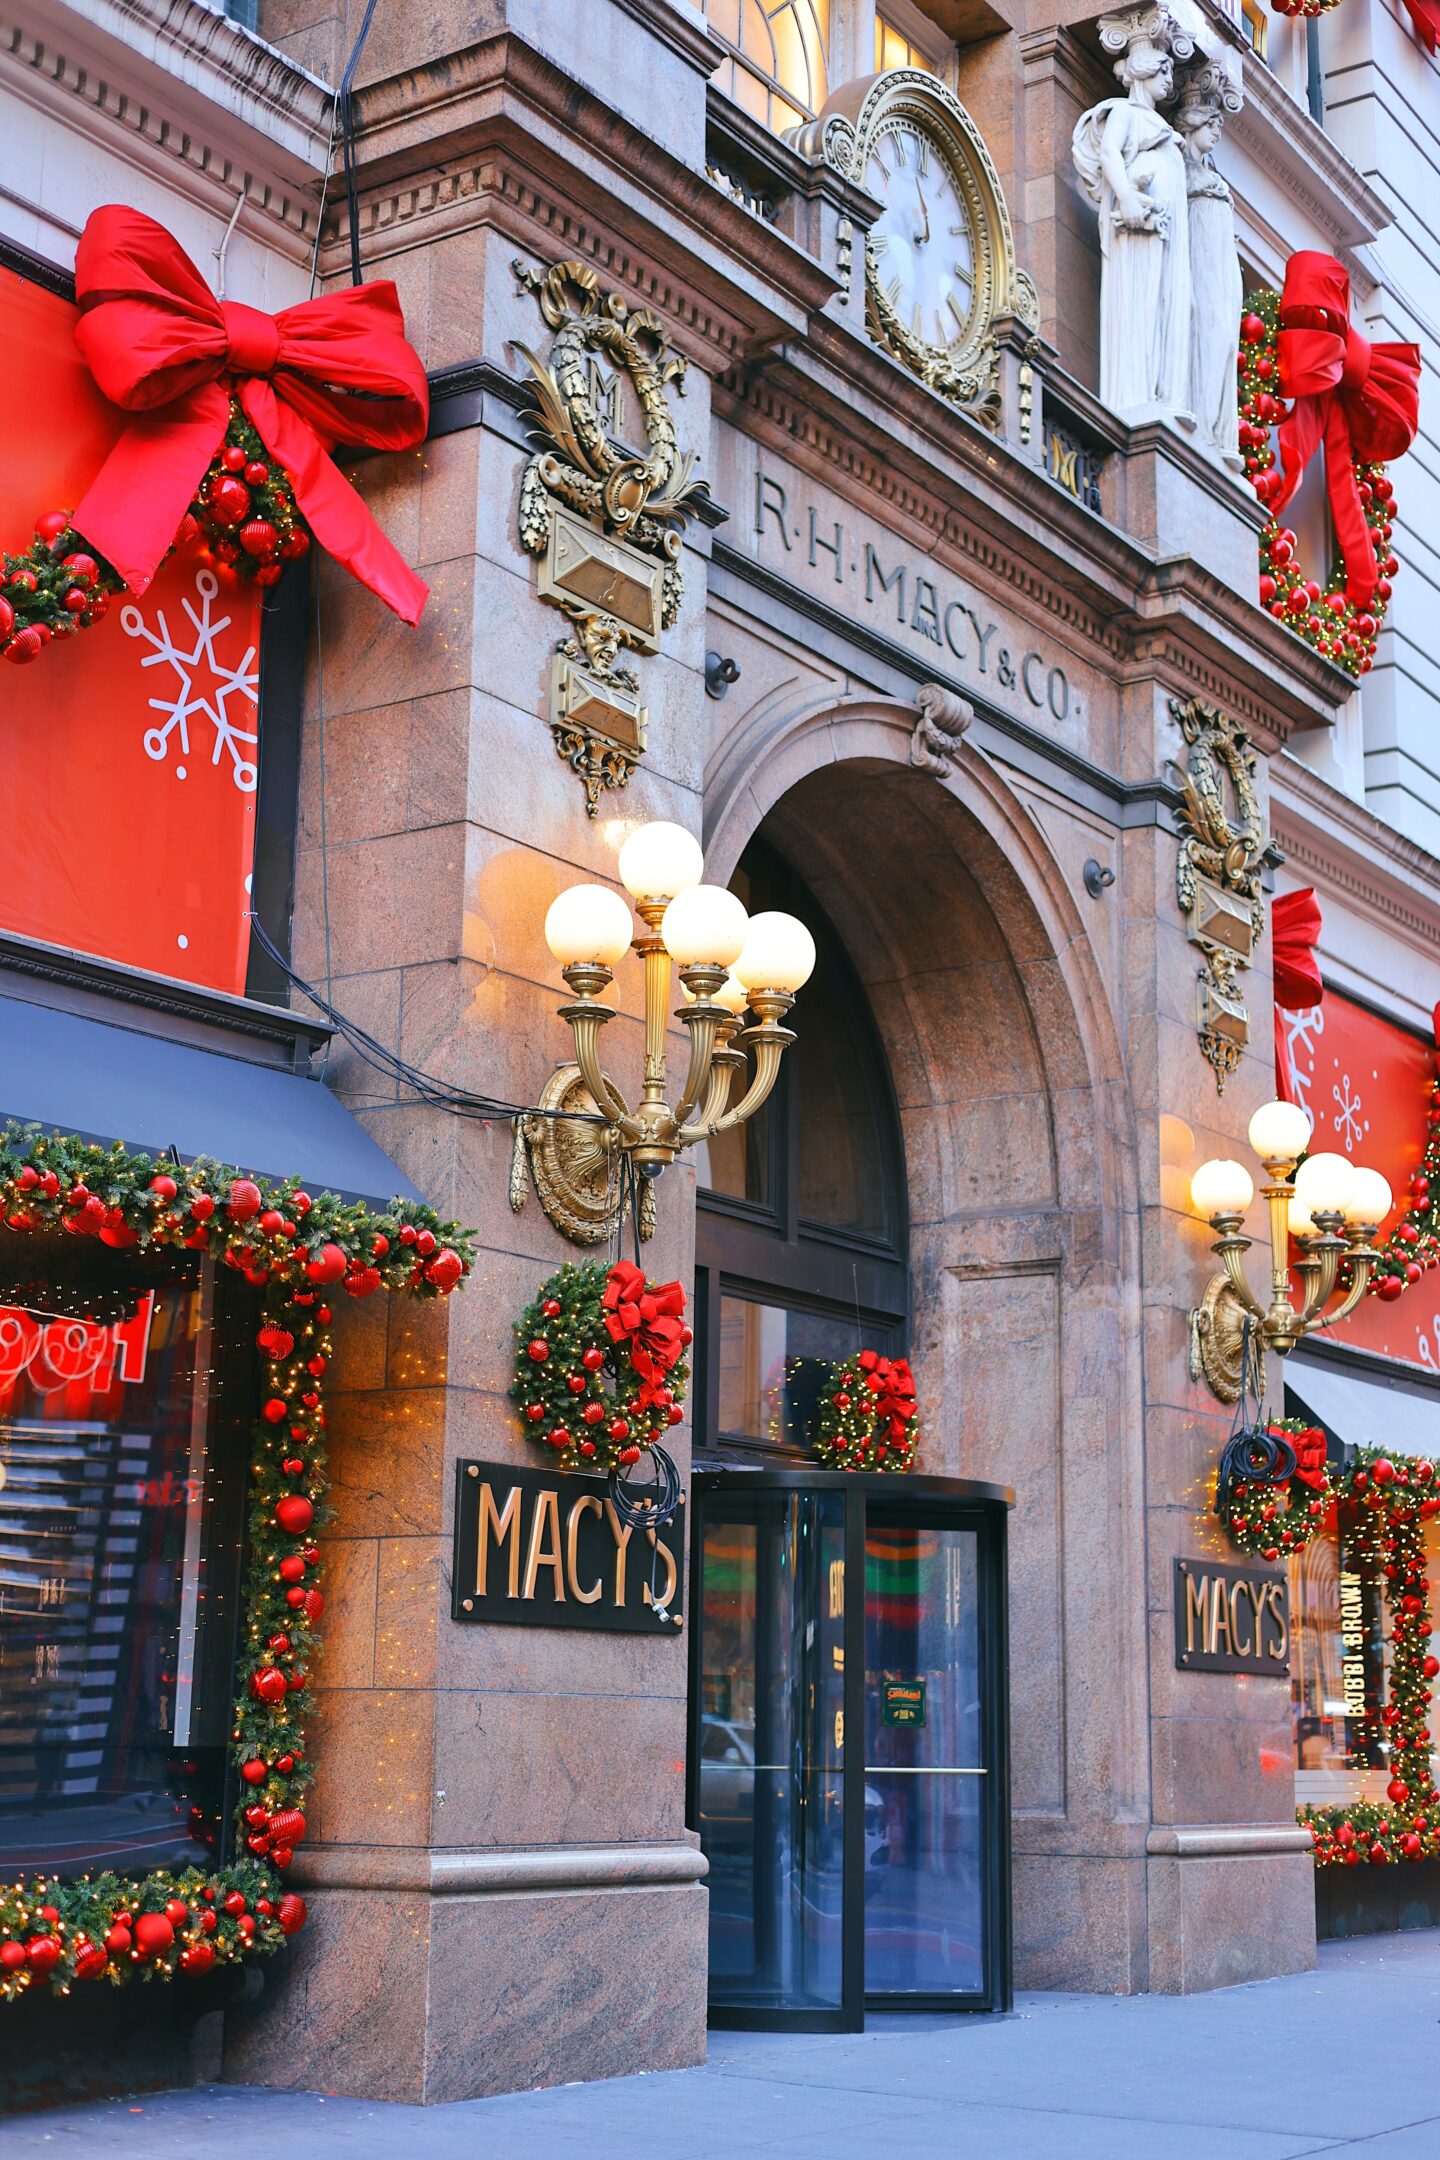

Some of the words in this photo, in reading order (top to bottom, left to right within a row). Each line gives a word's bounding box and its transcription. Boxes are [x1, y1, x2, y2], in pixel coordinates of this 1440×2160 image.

[1186, 1573, 1288, 1660] MACY'S
[1340, 1572, 1363, 1648] BROWN
[1343, 1654, 1366, 1717] BOBBI
